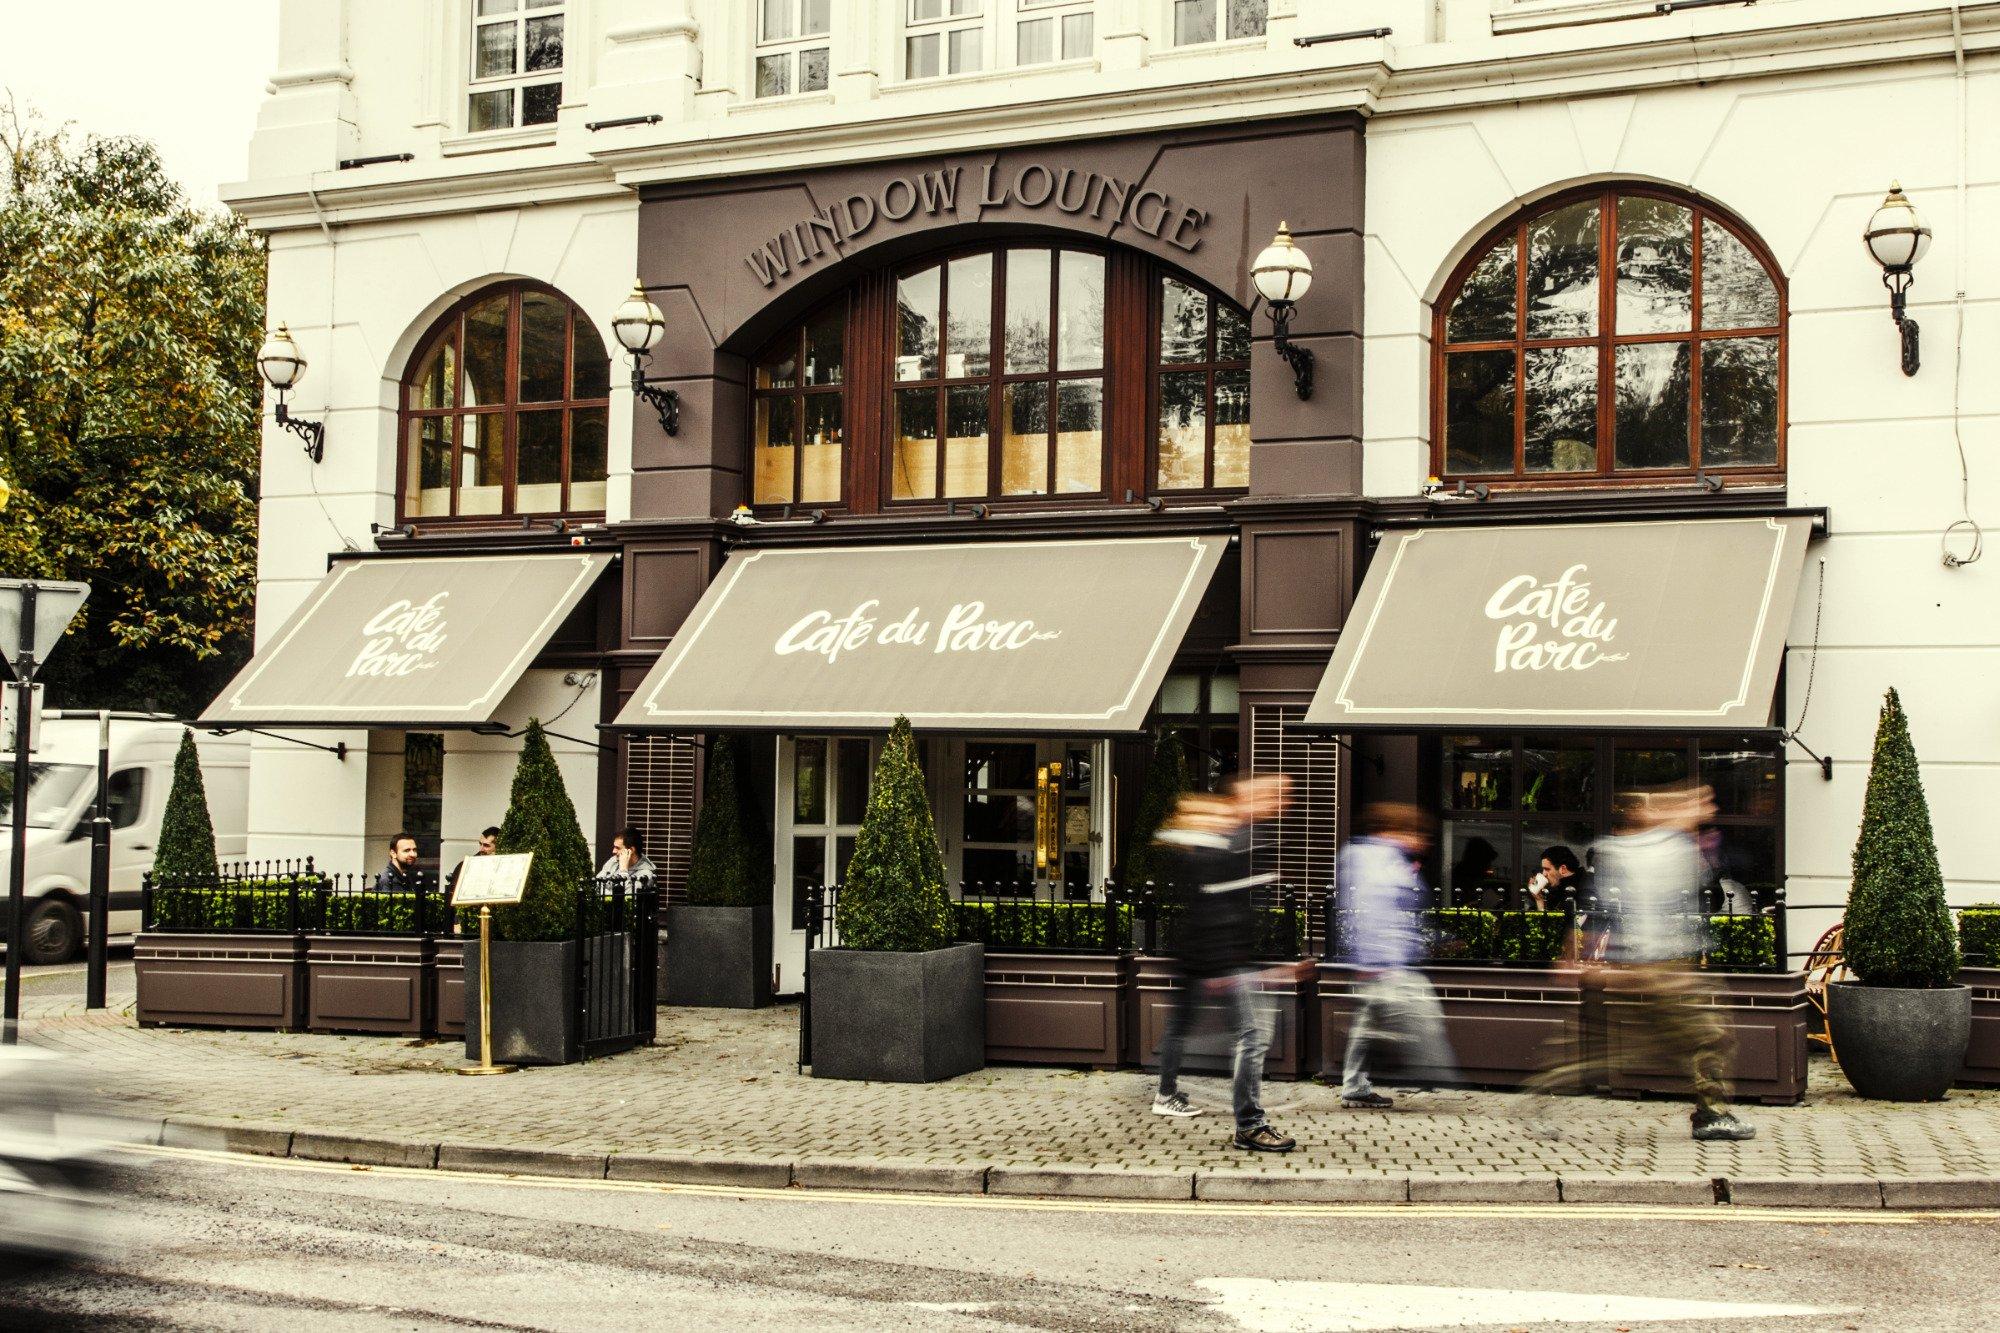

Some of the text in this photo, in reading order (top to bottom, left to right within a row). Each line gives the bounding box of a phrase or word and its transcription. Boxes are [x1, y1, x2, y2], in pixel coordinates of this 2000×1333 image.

[744, 163, 1209, 288] WINDOW LOUNGE
[362, 591, 450, 644] Café
[1485, 563, 1591, 629] Café
[1561, 601, 1618, 642] du
[344, 636, 440, 678] Parc
[405, 620, 448, 654] du
[774, 599, 1061, 664] Café du Parc
[1494, 621, 1630, 673] Parc
